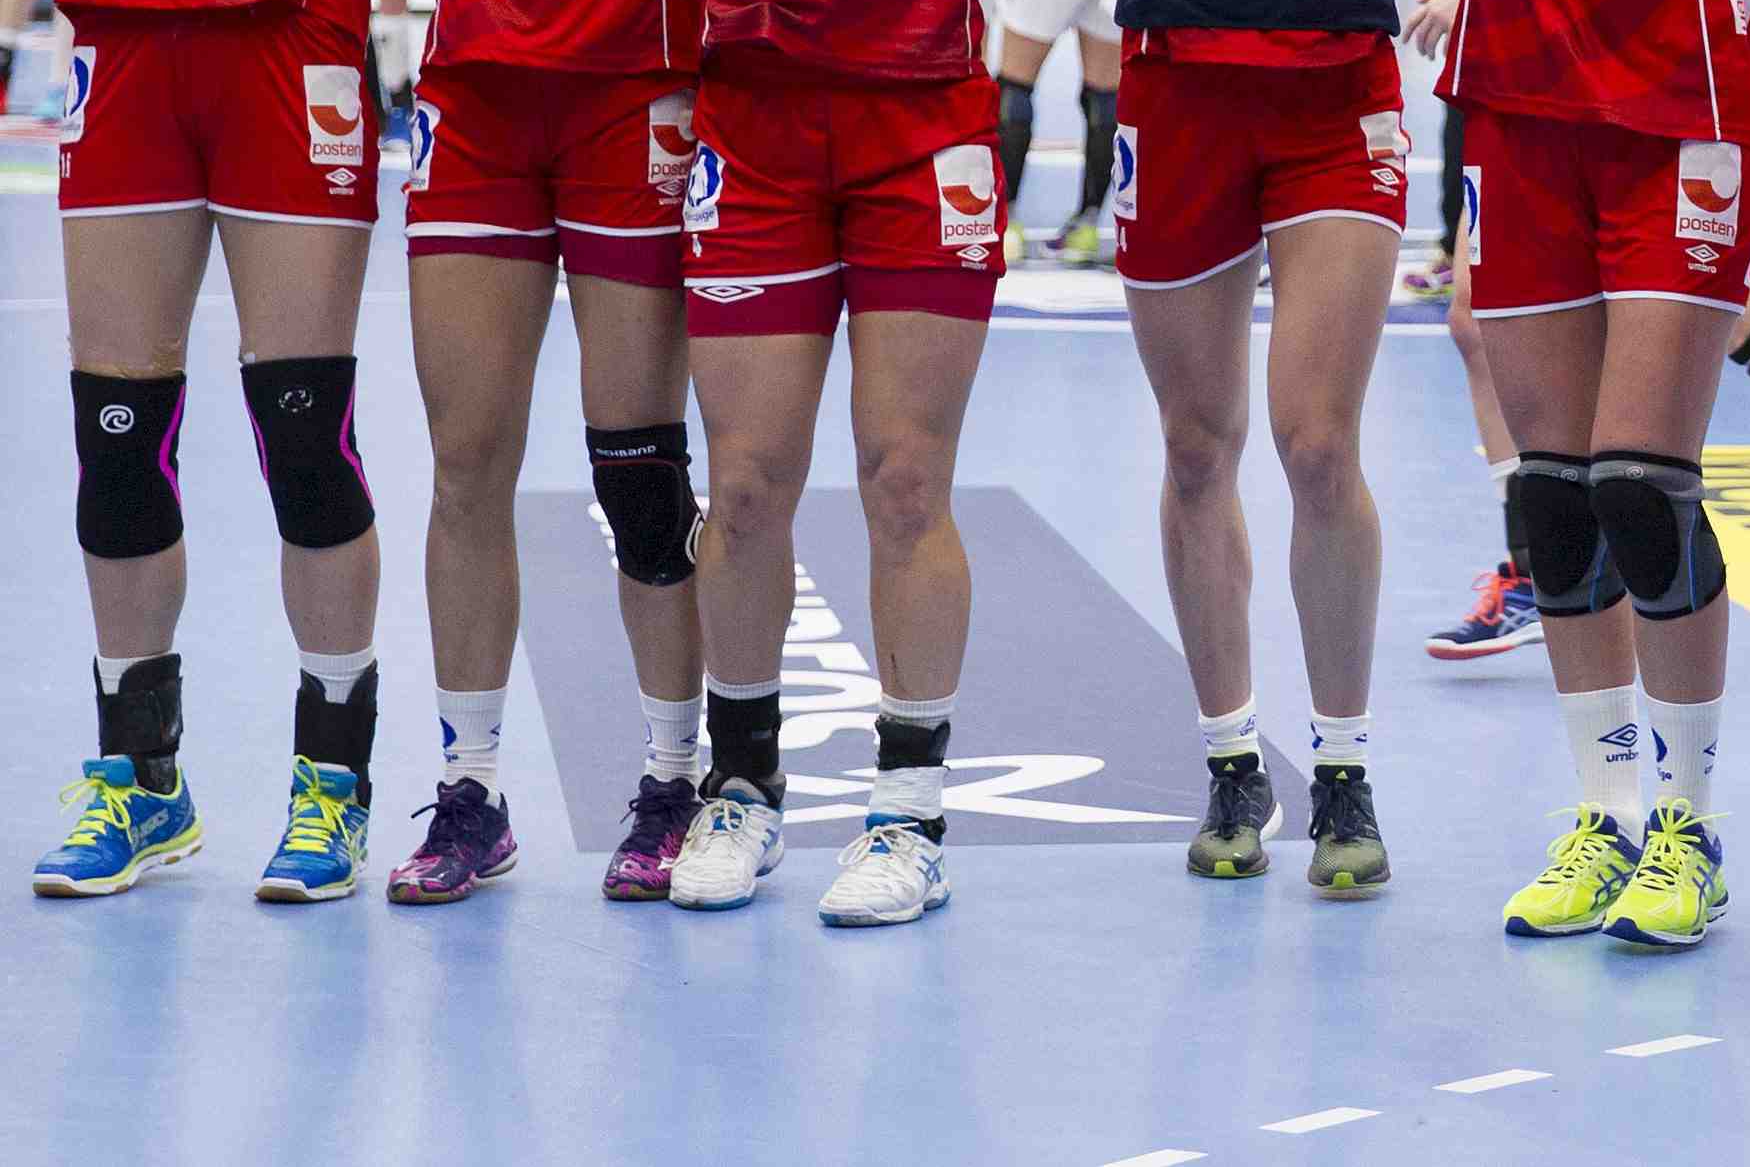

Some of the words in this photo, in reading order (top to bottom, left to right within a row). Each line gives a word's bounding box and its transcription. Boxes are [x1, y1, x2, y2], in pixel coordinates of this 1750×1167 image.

[312, 140, 363, 158] posten
[944, 220, 993, 241] posten
[1679, 216, 1735, 238] posten
